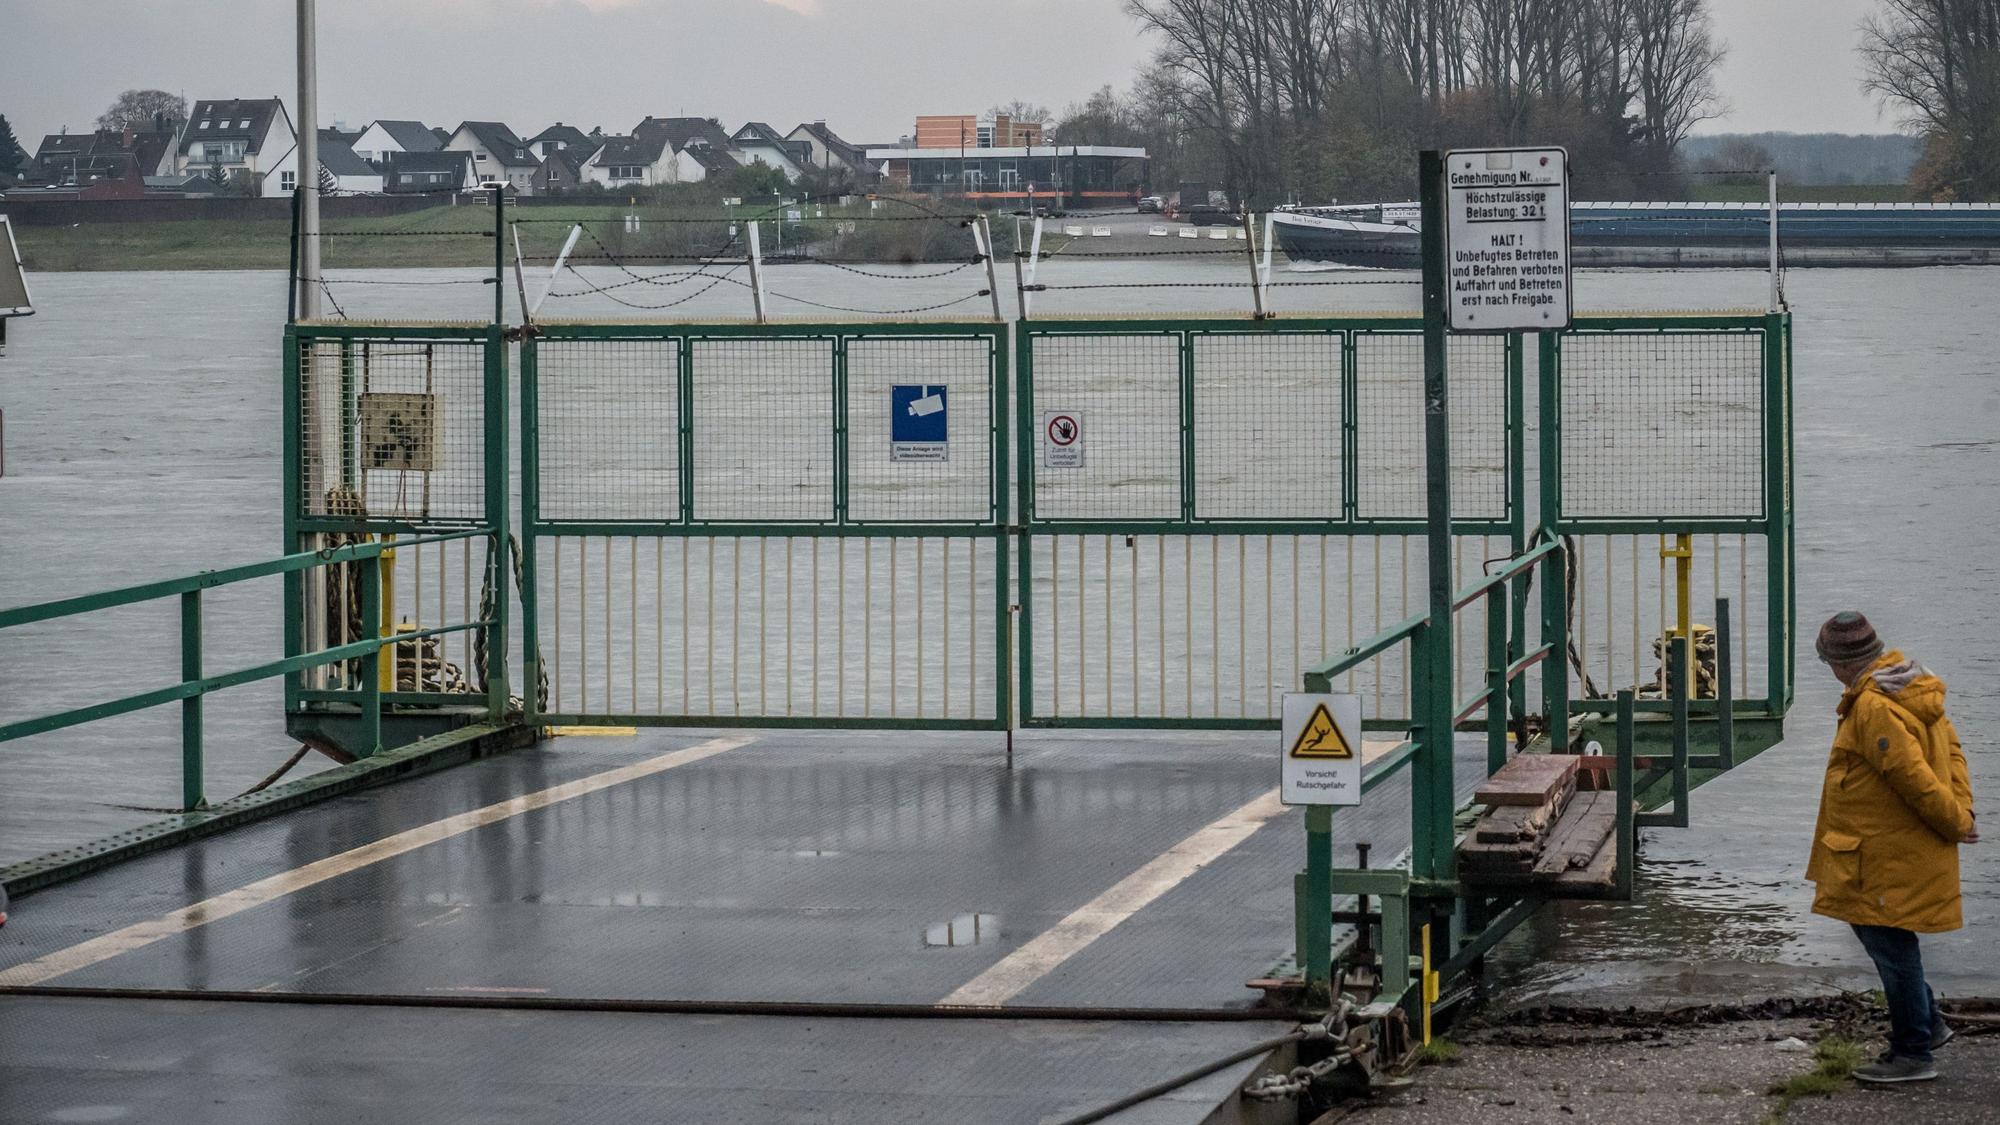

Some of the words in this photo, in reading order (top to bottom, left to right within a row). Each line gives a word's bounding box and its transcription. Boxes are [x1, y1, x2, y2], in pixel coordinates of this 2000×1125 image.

[1451, 172, 1516, 185] Genehmigung
[1520, 171, 1533, 182] Nr.
[1466, 190, 1546, 205] Höchstzulässige
[1466, 206, 1518, 219] Belastung:
[1522, 206, 1536, 217] 32
[1491, 234, 1516, 246] HALT
[1456, 250, 1512, 264] Unbefugtes
[1515, 249, 1558, 260] Betreten
[1452, 265, 1470, 277] und
[1473, 264, 1518, 276] Befahren
[1521, 264, 1564, 275] verboten
[1455, 279, 1496, 292] Auffahrt
[1498, 279, 1516, 290] und
[1520, 278, 1562, 290] Betreten
[1462, 294, 1482, 306] erst
[1485, 294, 1508, 305] nach
[1512, 293, 1556, 307] Freigabe.
[1296, 780, 1346, 790] Rutschgefahr
